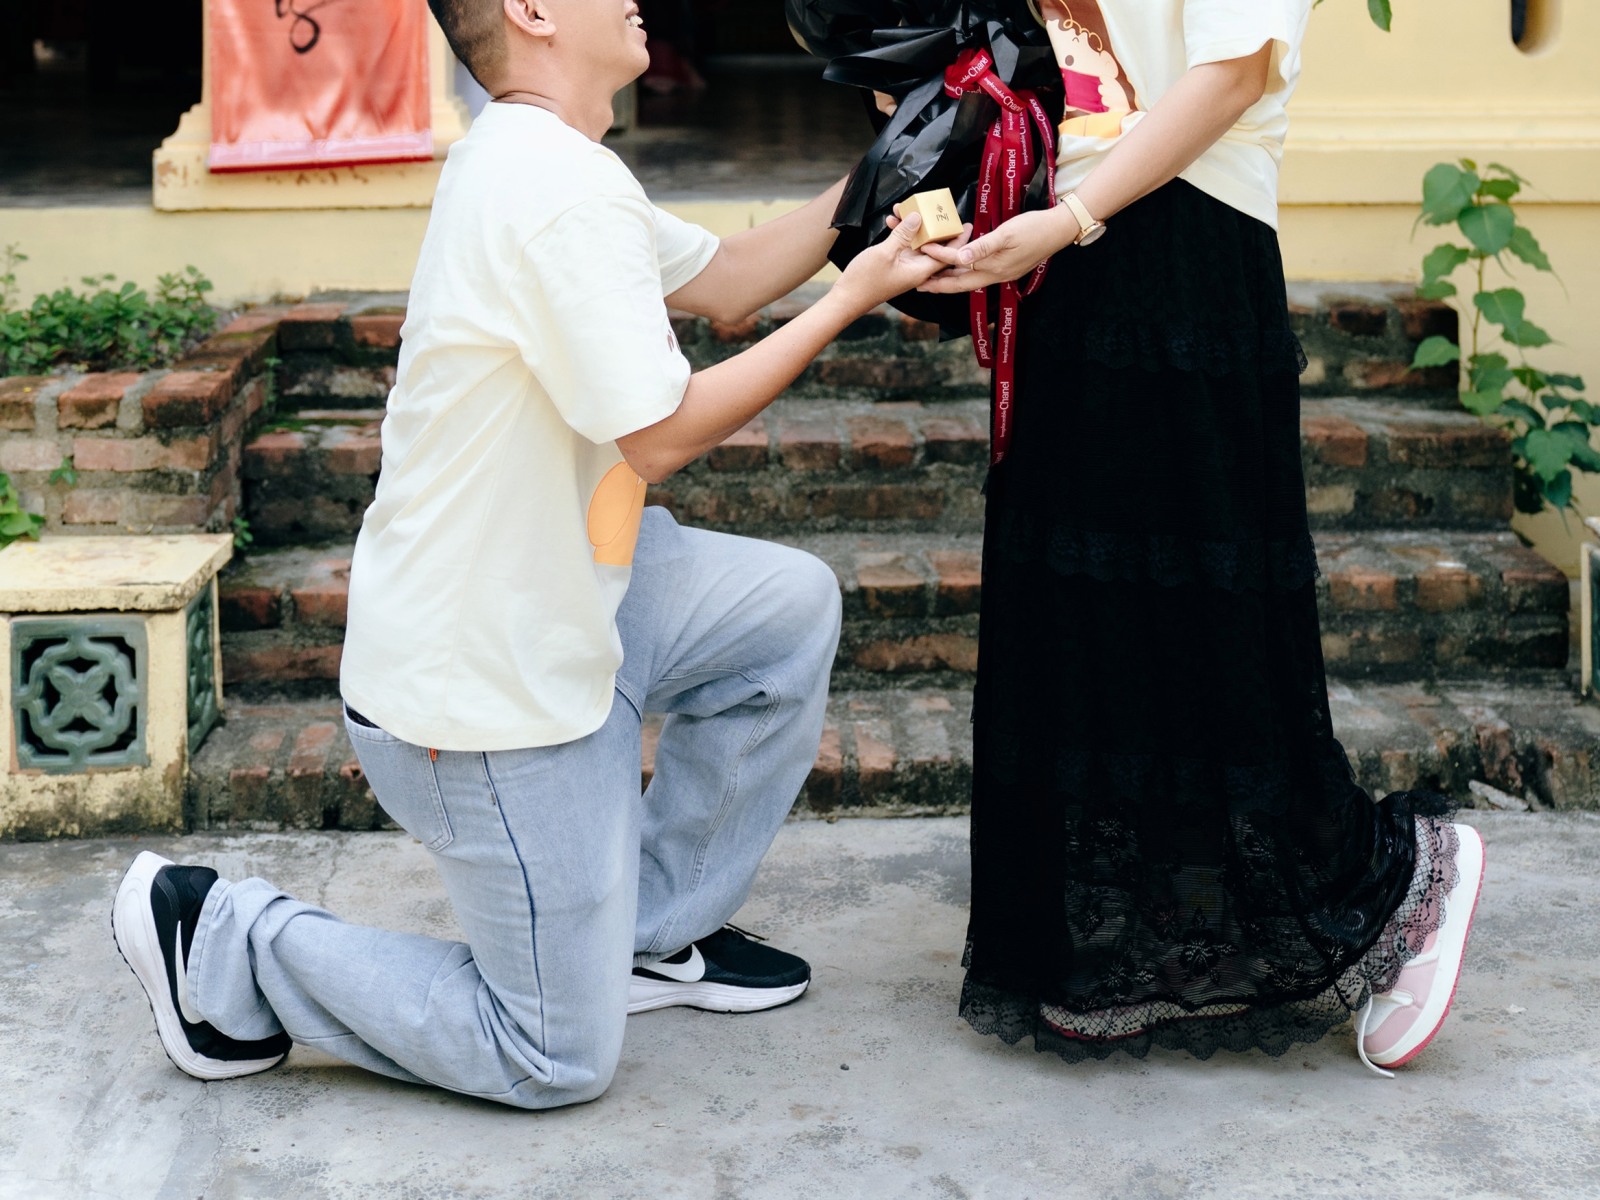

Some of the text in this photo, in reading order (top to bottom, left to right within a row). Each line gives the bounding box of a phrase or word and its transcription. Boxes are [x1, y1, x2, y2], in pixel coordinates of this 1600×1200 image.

[1005, 148, 1017, 180] Chanel
[979, 182, 991, 214] Chanel
[1001, 307, 1013, 336] Chanel
[999, 381, 1010, 411] Chanel
